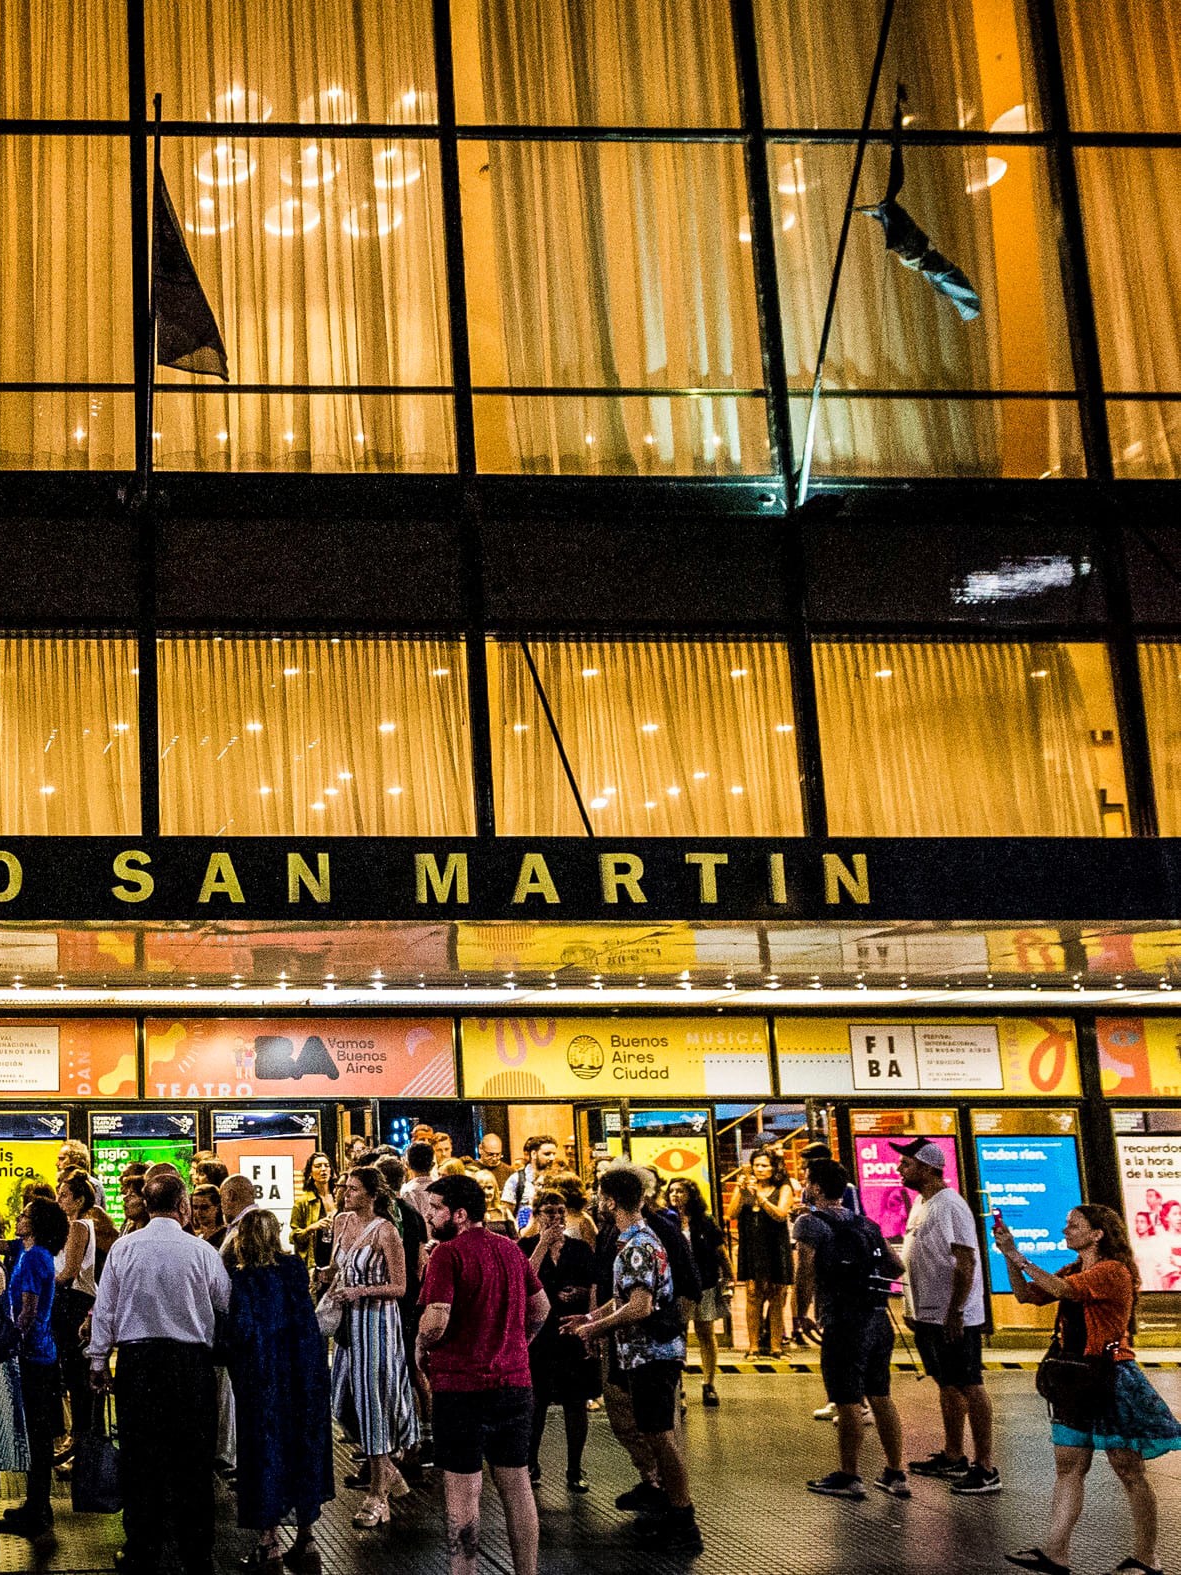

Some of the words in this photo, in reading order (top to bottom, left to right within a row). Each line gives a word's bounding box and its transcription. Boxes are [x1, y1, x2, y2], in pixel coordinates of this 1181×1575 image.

[111, 850, 330, 904] SAN
[415, 851, 870, 905] MARTIN
[328, 1037, 375, 1050] Vamos
[610, 1034, 668, 1048] Buenos
[337, 1050, 387, 1062] Buenos
[612, 1050, 655, 1064] Aires
[346, 1062, 384, 1074] Aires
[613, 1067, 669, 1080] Ciudad
[155, 1083, 253, 1097] TEATRO
[98, 1149, 129, 1161] siglo
[861, 1143, 878, 1160] el
[98, 1161, 115, 1172] de
[1125, 1158, 1131, 1166] a
[1134, 1155, 1145, 1166] la
[1147, 1155, 1173, 1166] hora
[1126, 1169, 1141, 1179] de
[1144, 1169, 1154, 1179] la
[1004, 1183, 1046, 1193] manos
